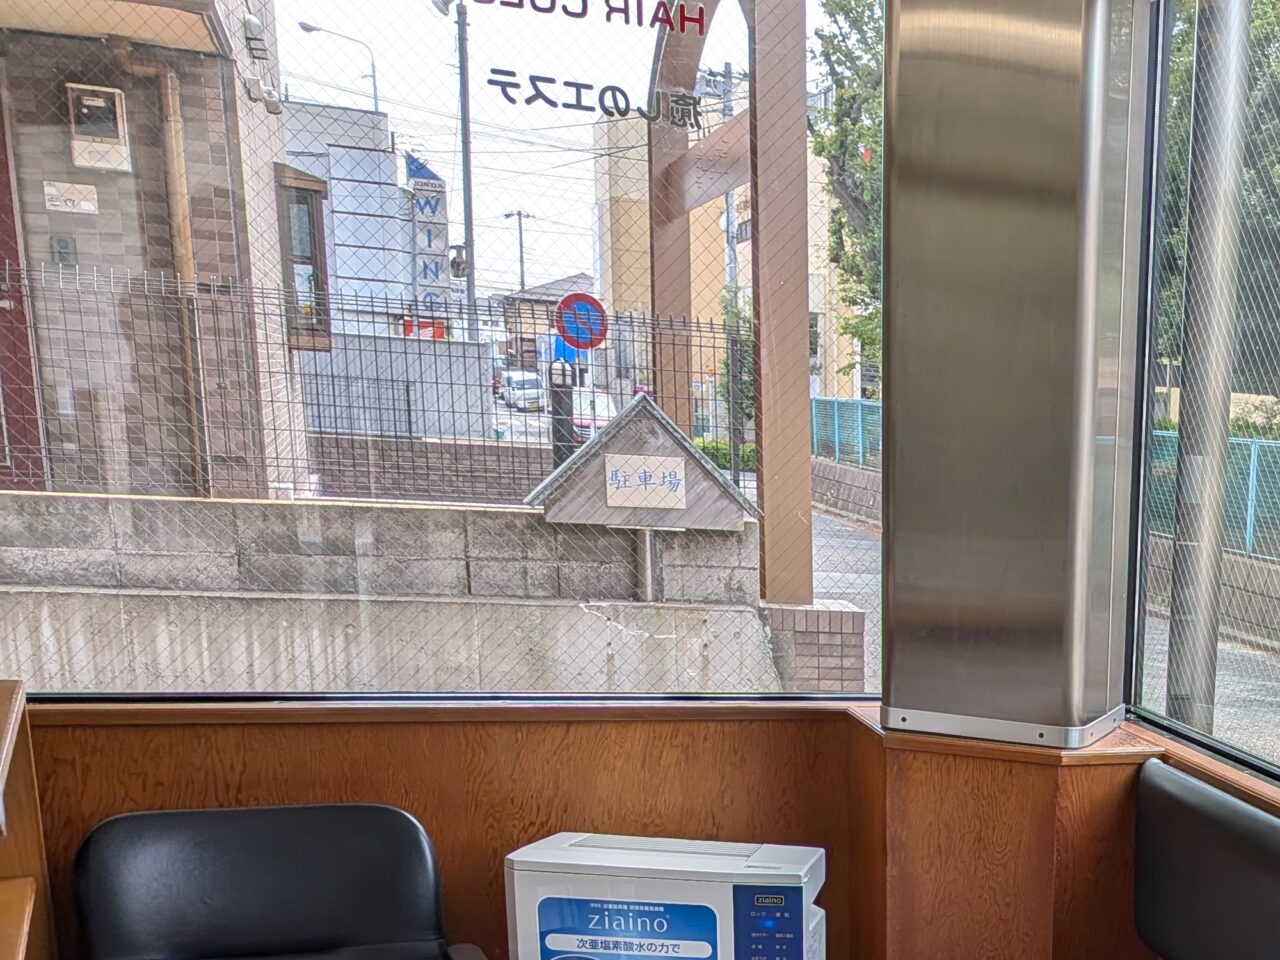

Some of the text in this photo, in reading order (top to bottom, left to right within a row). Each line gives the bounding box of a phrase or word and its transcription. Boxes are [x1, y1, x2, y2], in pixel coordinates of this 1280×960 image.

[415, 197, 445, 312] WING
[609, 469, 681, 492] 駐車場
[588, 912, 668, 932] ziaino
[576, 938, 681, 954] 次亜塩素酸水の力で
